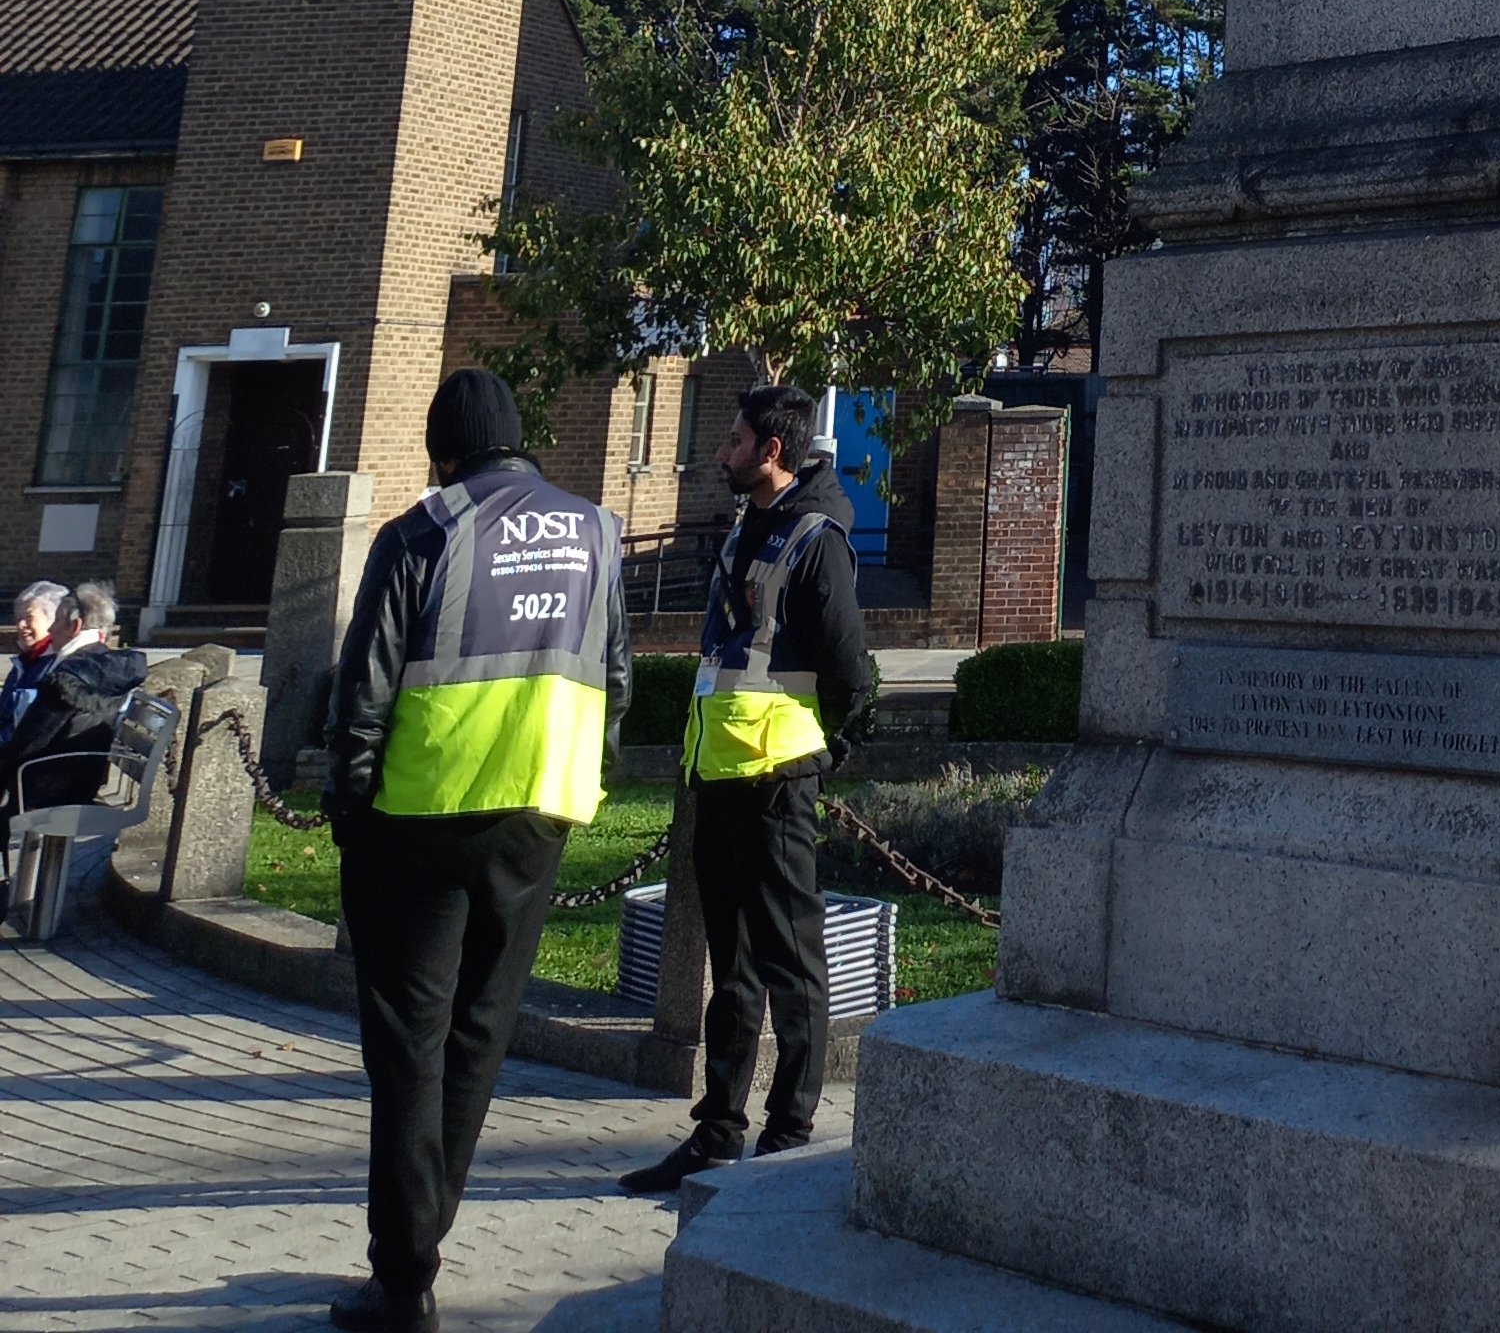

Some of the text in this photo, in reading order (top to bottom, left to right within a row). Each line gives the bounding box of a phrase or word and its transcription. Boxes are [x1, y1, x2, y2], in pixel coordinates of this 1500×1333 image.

[1246, 363, 1270, 386] TO
[1279, 362, 1314, 383] THE
[1322, 359, 1381, 383] GLORY
[1390, 358, 1414, 380] OF
[1191, 391, 1209, 412] IN
[1214, 390, 1290, 411] HONOUR
[1299, 390, 1319, 410] OF
[1327, 387, 1391, 408] THOSE
[1397, 385, 1440, 407] WHO
[1174, 419, 1190, 437] IN
[1193, 416, 1279, 437] SYMPATHY
[1286, 415, 1331, 435] WITH
[1341, 413, 1395, 435] THOSE
[1402, 412, 1443, 433] WHO
[1329, 440, 1369, 461] AND
[1173, 471, 1188, 491] IN
[1192, 470, 1248, 490] PROUD
[1252, 470, 1288, 490] AND
[1295, 469, 1392, 491] GRATEFUL
[1268, 496, 1430, 518] OF THE MEN OF
[1177, 520, 1269, 548] LEYTON
[1281, 529, 1323, 549] AND
[492, 550, 521, 565] Security
[522, 547, 551, 561] Services
[1206, 553, 1246, 575] WHO
[1252, 554, 1300, 576] FELL
[1306, 554, 1324, 577] IN
[1335, 556, 1371, 579] THE
[1381, 557, 1449, 580] GREAT
[510, 592, 567, 621] 5022
[1219, 670, 1462, 700] IN MEMORY OF THE FALLEN OF
[1232, 692, 1449, 725] LEYTON AND LEYTONSTONE
[1222, 716, 1240, 735] TO
[1245, 716, 1310, 739] PRESENT
[1317, 721, 1347, 741] DAY
[1356, 724, 1395, 745] LEST
[1402, 726, 1424, 749] WE
